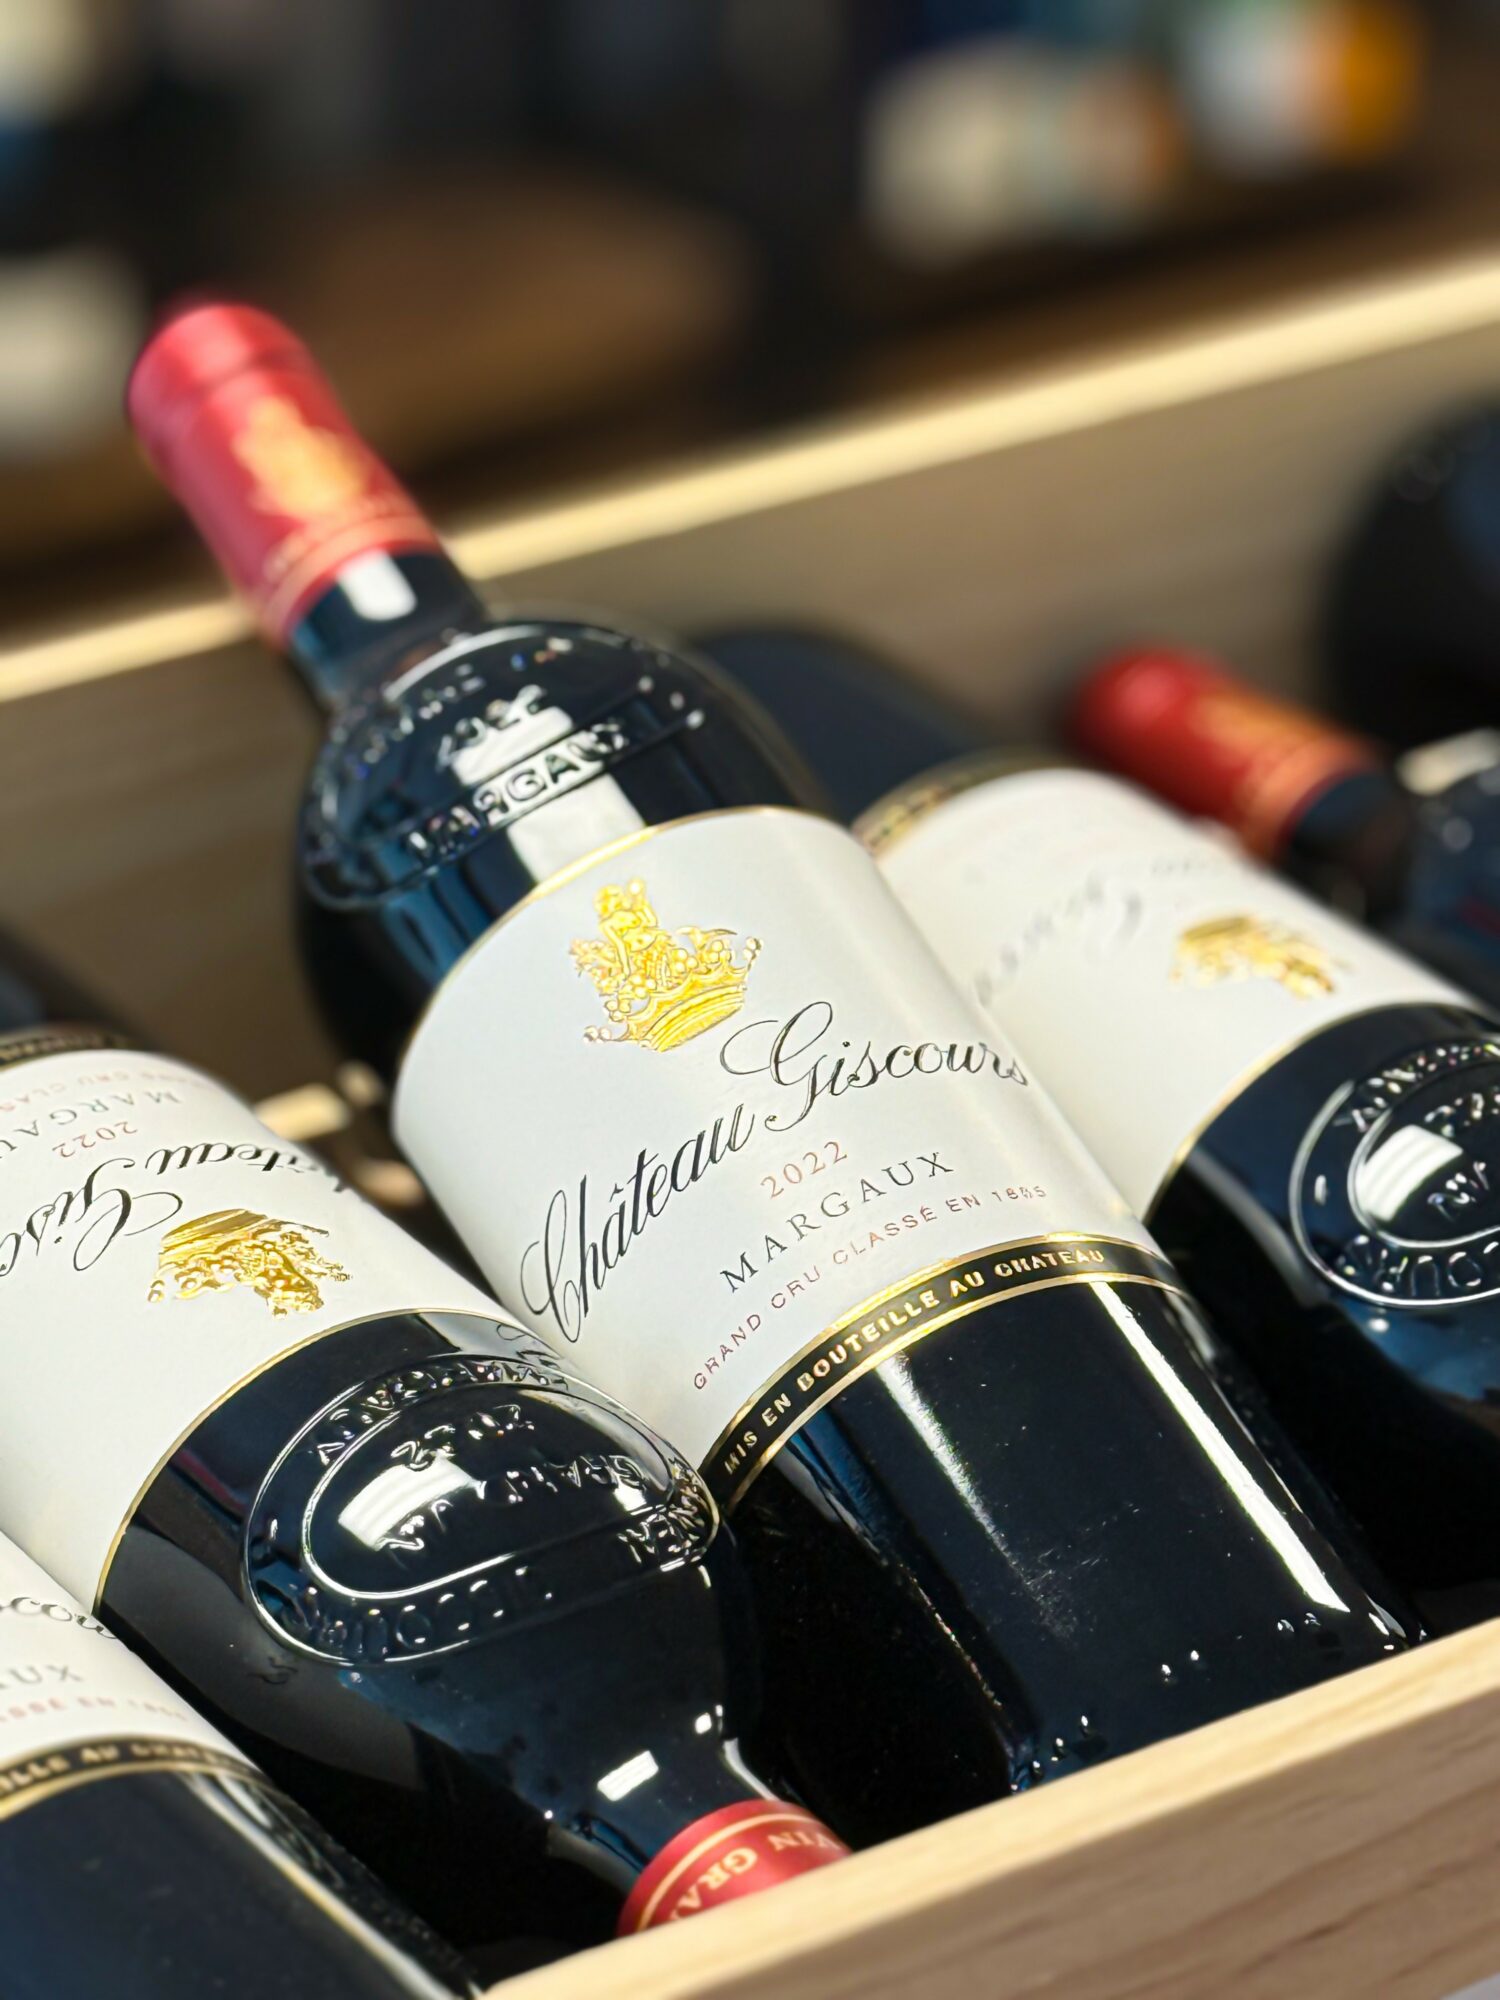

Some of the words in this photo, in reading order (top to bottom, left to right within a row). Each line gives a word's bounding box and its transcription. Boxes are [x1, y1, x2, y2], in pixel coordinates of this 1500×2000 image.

[52, 1121, 138, 1158] 2022
[520, 1103, 756, 1344] Château
[719, 1000, 1028, 1132] Giscours
[760, 1141, 848, 1200] 2022
[719, 1152, 954, 1294] MARGAUX
[693, 1313, 762, 1391] GRAND
[770, 1264, 822, 1310] CRU
[832, 1204, 938, 1267] CLASSÉ
[945, 1193, 982, 1213] EN
[724, 1430, 758, 1476] MIS
[761, 1392, 792, 1428] EN
[796, 1288, 942, 1393] BOUTEILLE
[950, 1270, 986, 1298] AU
[993, 1249, 1105, 1278] CHATEAU
[0, 1664, 84, 1691] UX
[767, 1831, 842, 1852] VIN
